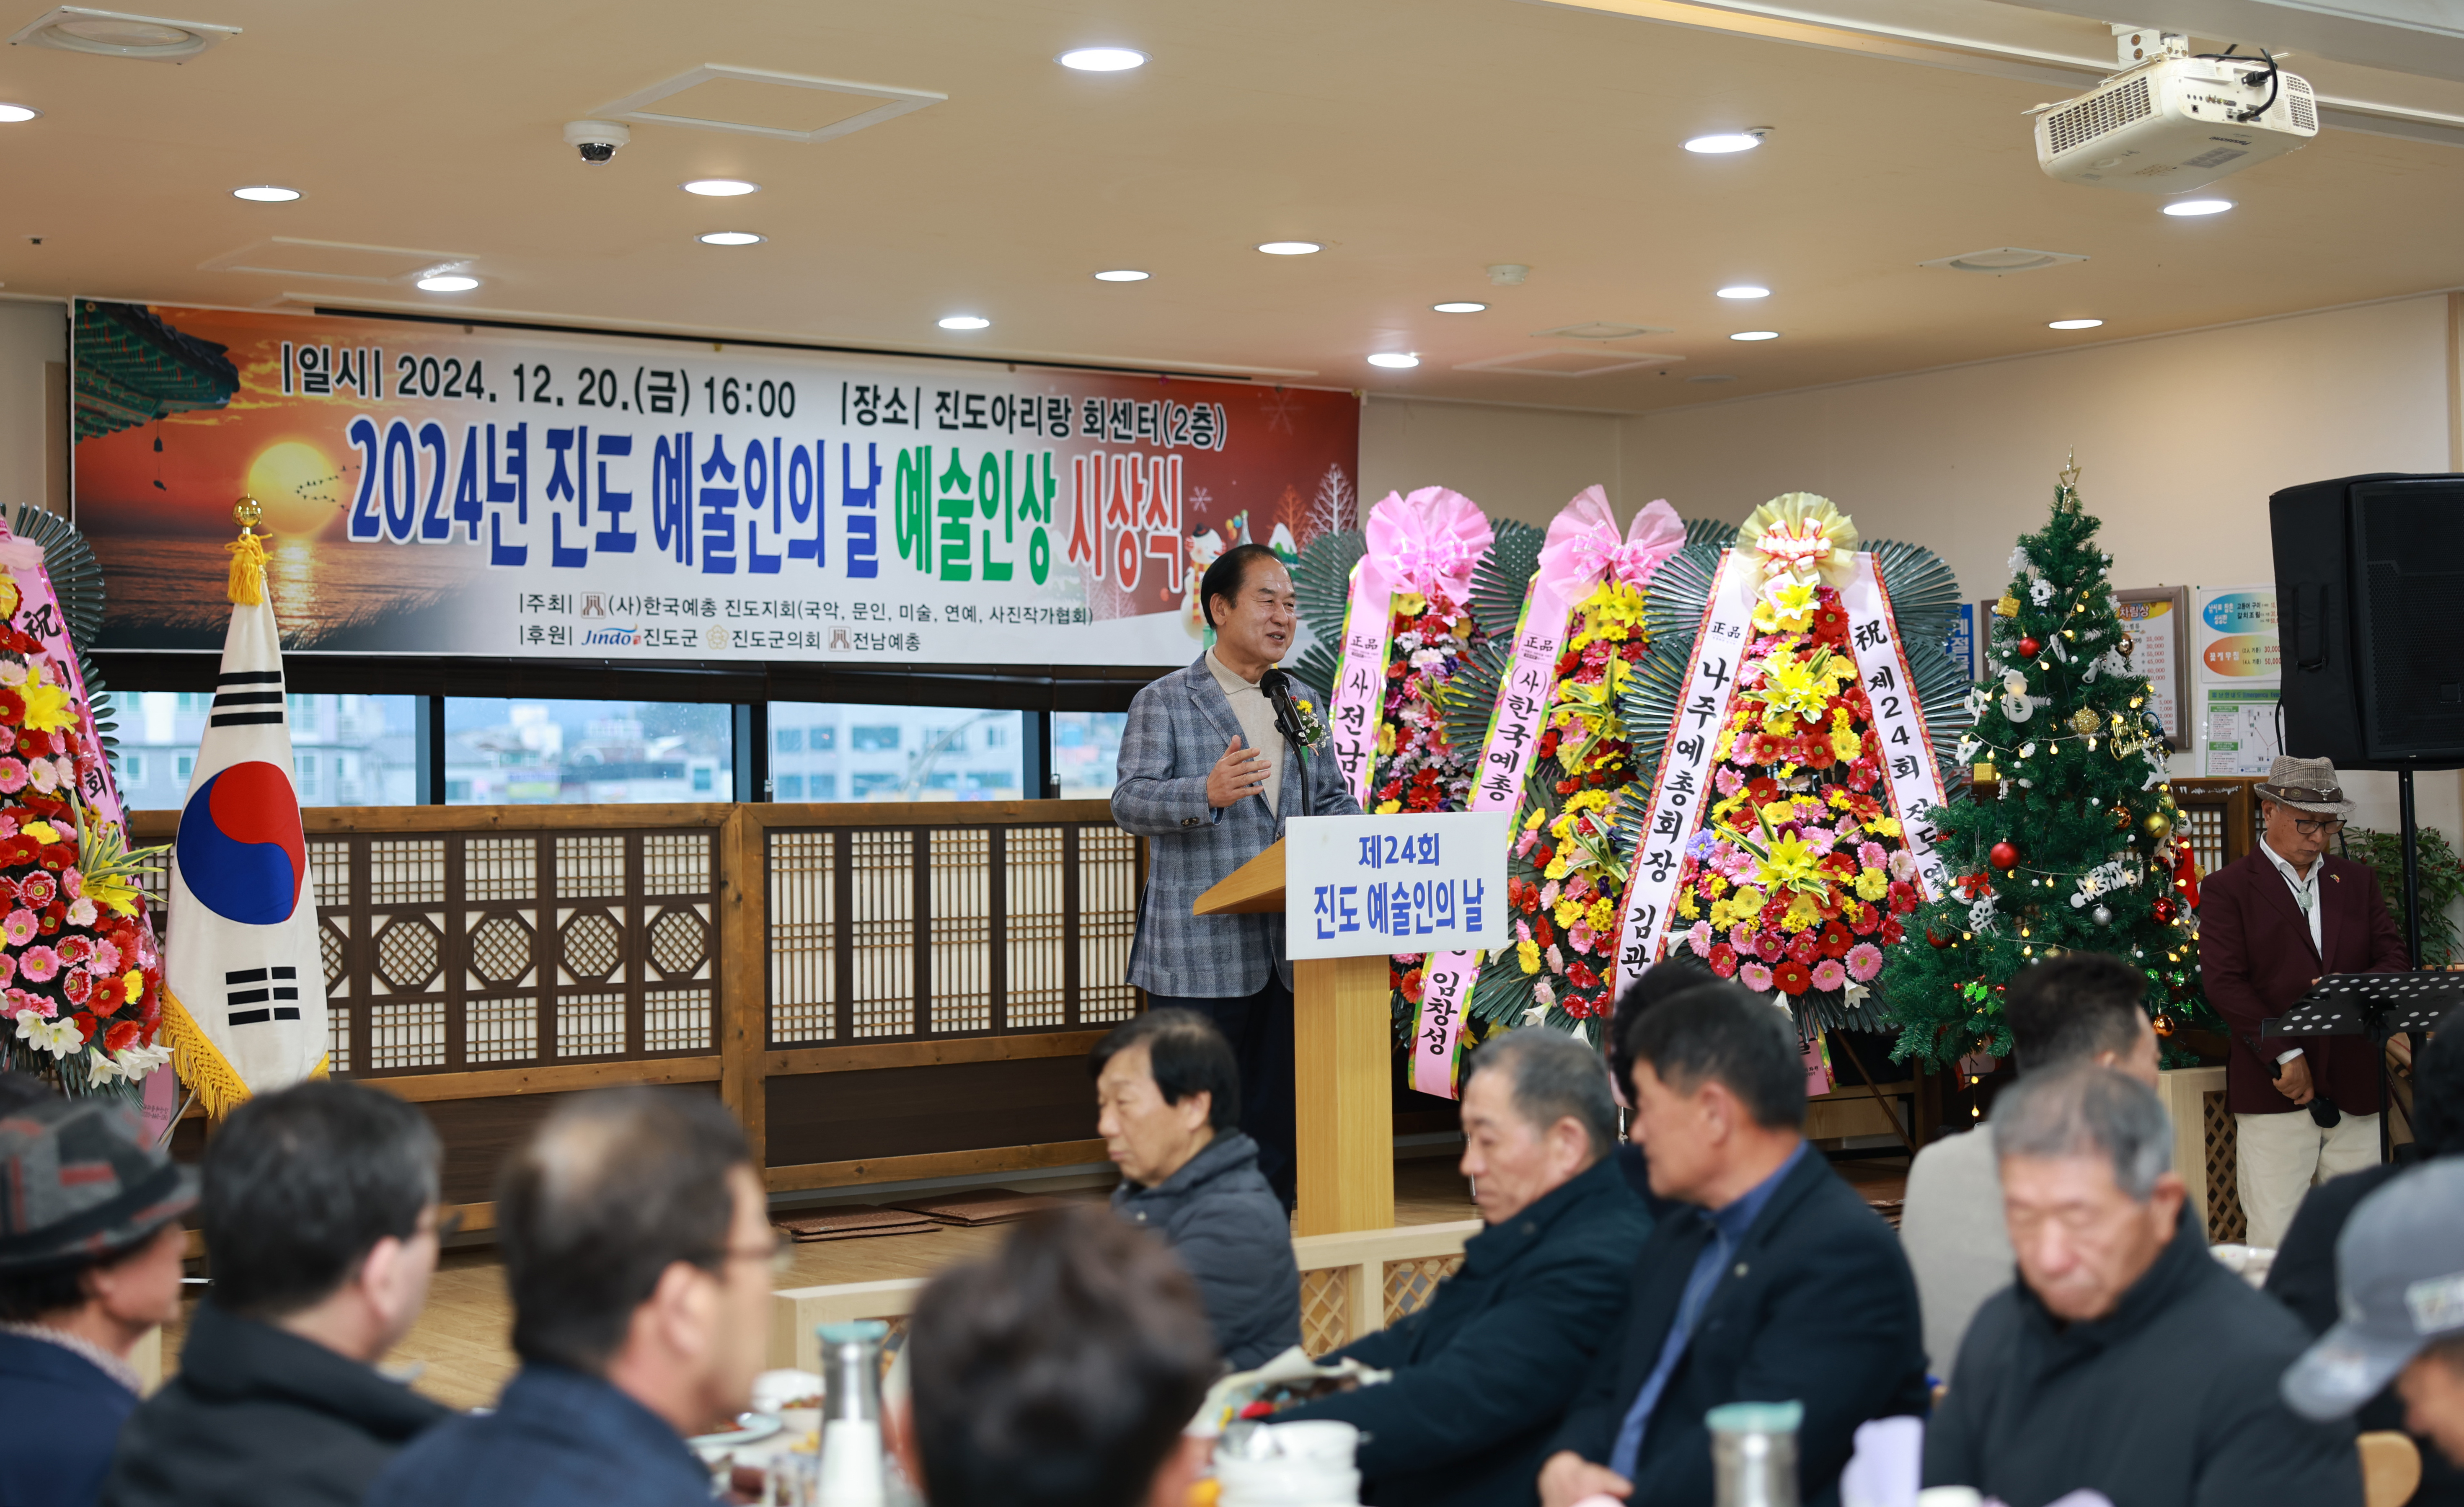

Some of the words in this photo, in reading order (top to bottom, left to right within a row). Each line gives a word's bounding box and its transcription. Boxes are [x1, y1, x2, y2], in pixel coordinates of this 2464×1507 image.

[397, 354, 497, 403] 2024.
[513, 363, 564, 406] 12.
[578, 366, 690, 416] 20.(금)
[705, 377, 795, 418] 16:00
[935, 390, 1072, 438] 진도아리랑
[1083, 400, 1226, 449] 회센터(2층)
[350, 419, 528, 566] 2024년
[546, 425, 636, 568] 진도
[652, 432, 825, 574] 예술인의
[842, 442, 882, 578] 날
[895, 445, 1056, 585] 예술인상
[1068, 455, 1180, 588] 시상식
[608, 595, 717, 618] (사)한국예총
[852, 602, 892, 623] 문인,
[900, 604, 938, 623] 미술,
[944, 604, 983, 624] 연예,
[989, 606, 1094, 626] 사진작가협회)
[644, 628, 698, 647] 진도군
[732, 629, 820, 650] 진도군의회
[853, 632, 921, 651] 전남예총
[1854, 620, 1888, 652] 祝
[1481, 664, 1548, 801] (사)한국예총
[1867, 665, 1920, 780] 제24회
[1358, 832, 1440, 869] 제24회
[1313, 884, 1360, 940] 진도
[1367, 879, 1456, 936] 예술인의
[1462, 878, 1485, 933] 날
[1420, 971, 1460, 1055] 임창성
